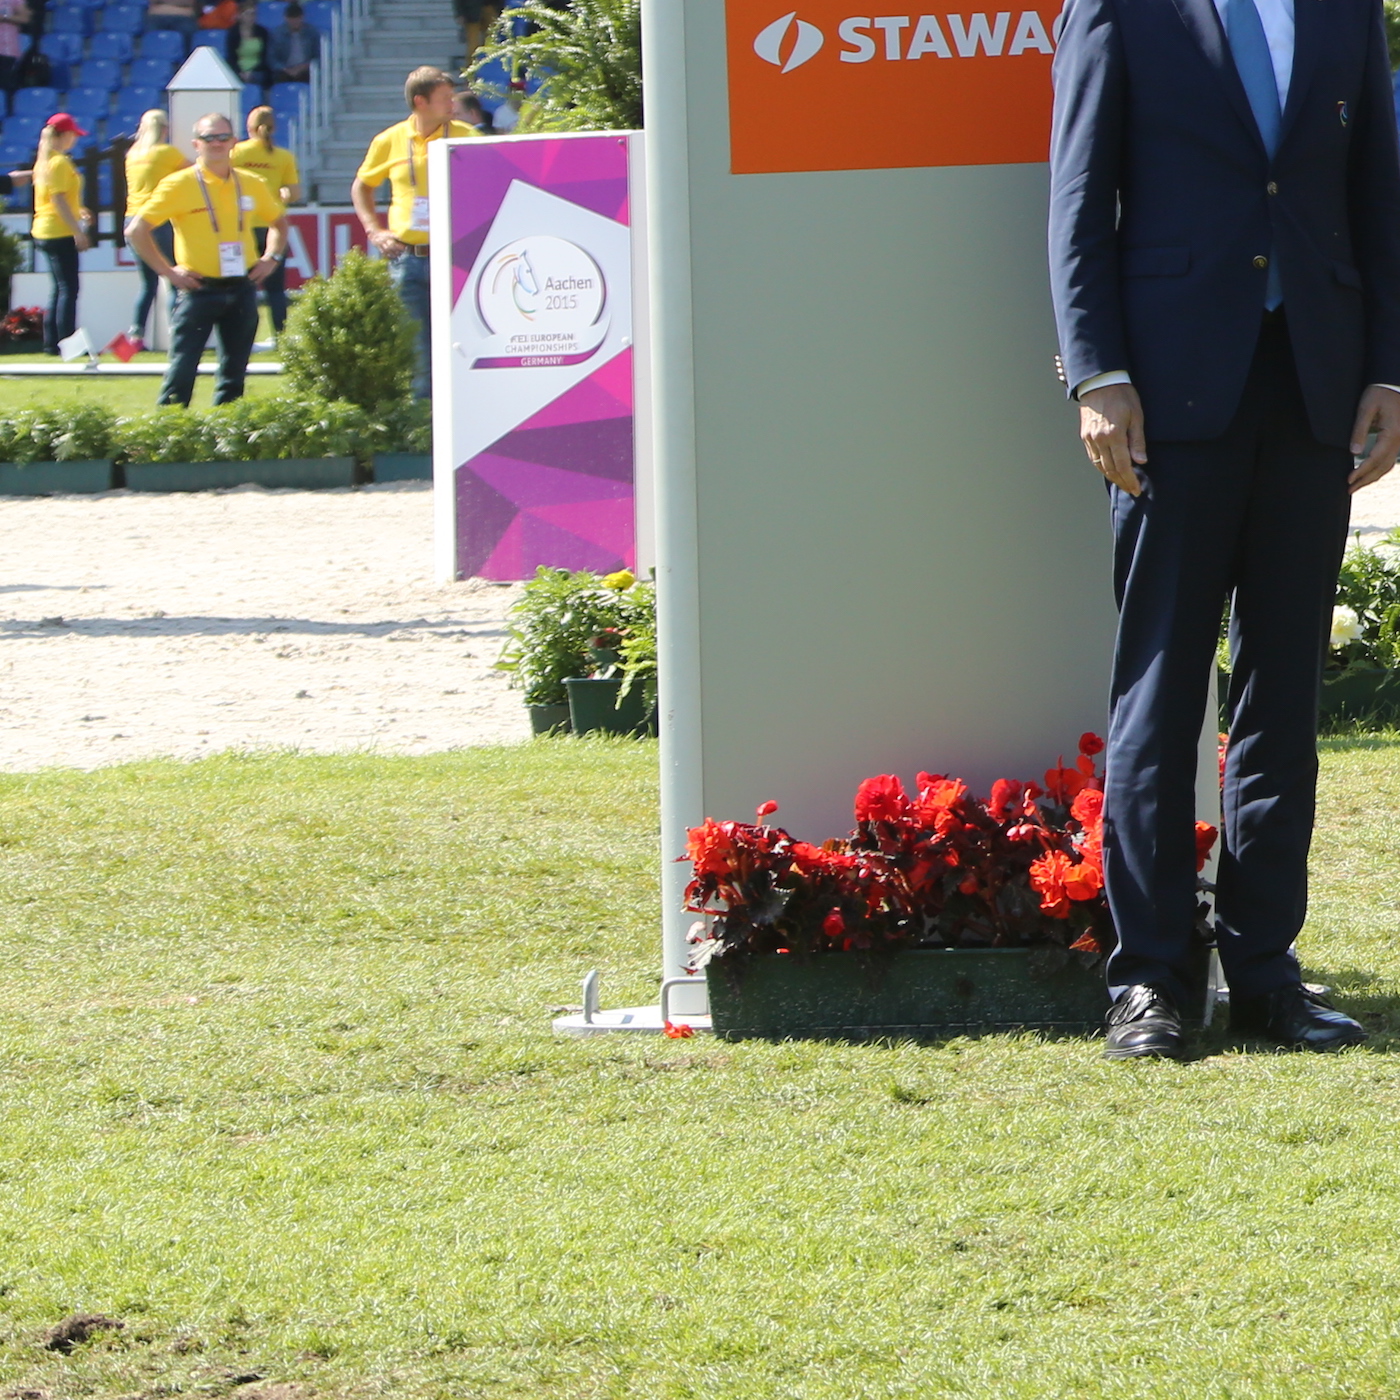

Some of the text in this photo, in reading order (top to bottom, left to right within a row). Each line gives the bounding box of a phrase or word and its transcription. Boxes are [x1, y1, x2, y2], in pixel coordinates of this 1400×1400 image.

[838, 10, 1064, 63] STAWA
[544, 276, 592, 291] Aachen
[545, 295, 577, 310] 2015
[531, 333, 574, 342] EUROPEAN
[505, 343, 578, 353] CHAMPIONSHIPS
[521, 356, 562, 366] GERMANY
